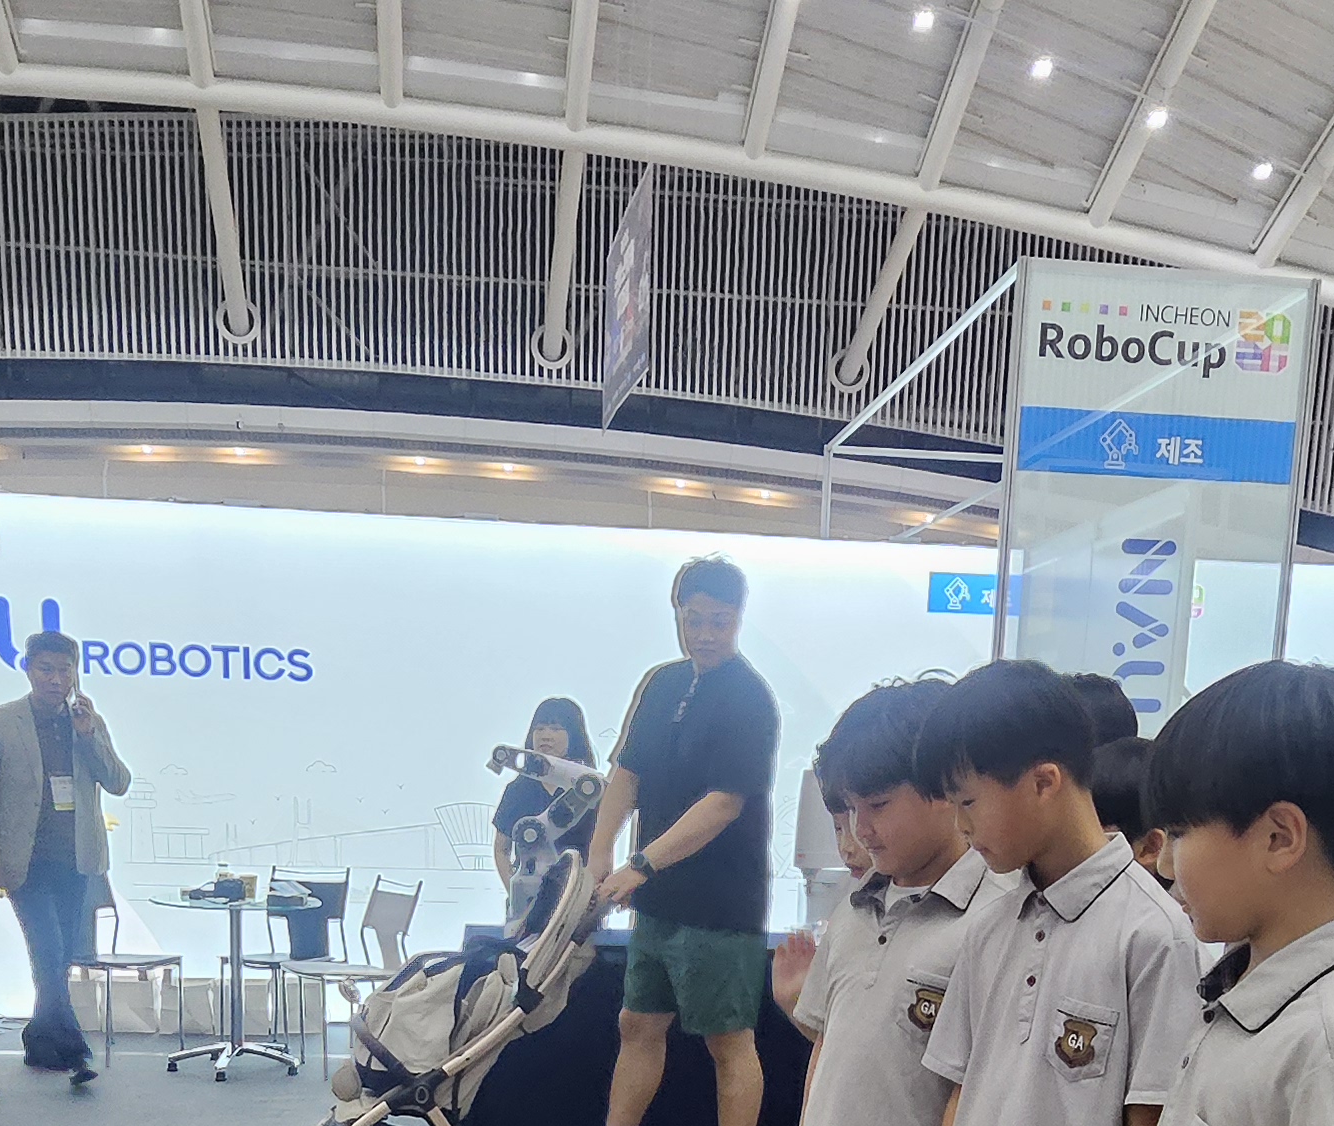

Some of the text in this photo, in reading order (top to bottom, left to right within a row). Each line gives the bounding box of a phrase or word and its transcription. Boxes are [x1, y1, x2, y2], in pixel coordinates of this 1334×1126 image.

[1140, 304, 1231, 327] INCHEON
[1038, 322, 1227, 379] RoboCup
[1155, 436, 1204, 466] 제조
[81, 640, 314, 682] ROBOTICS
[921, 1001, 936, 1017] GA
[1068, 1033, 1084, 1051] GA
